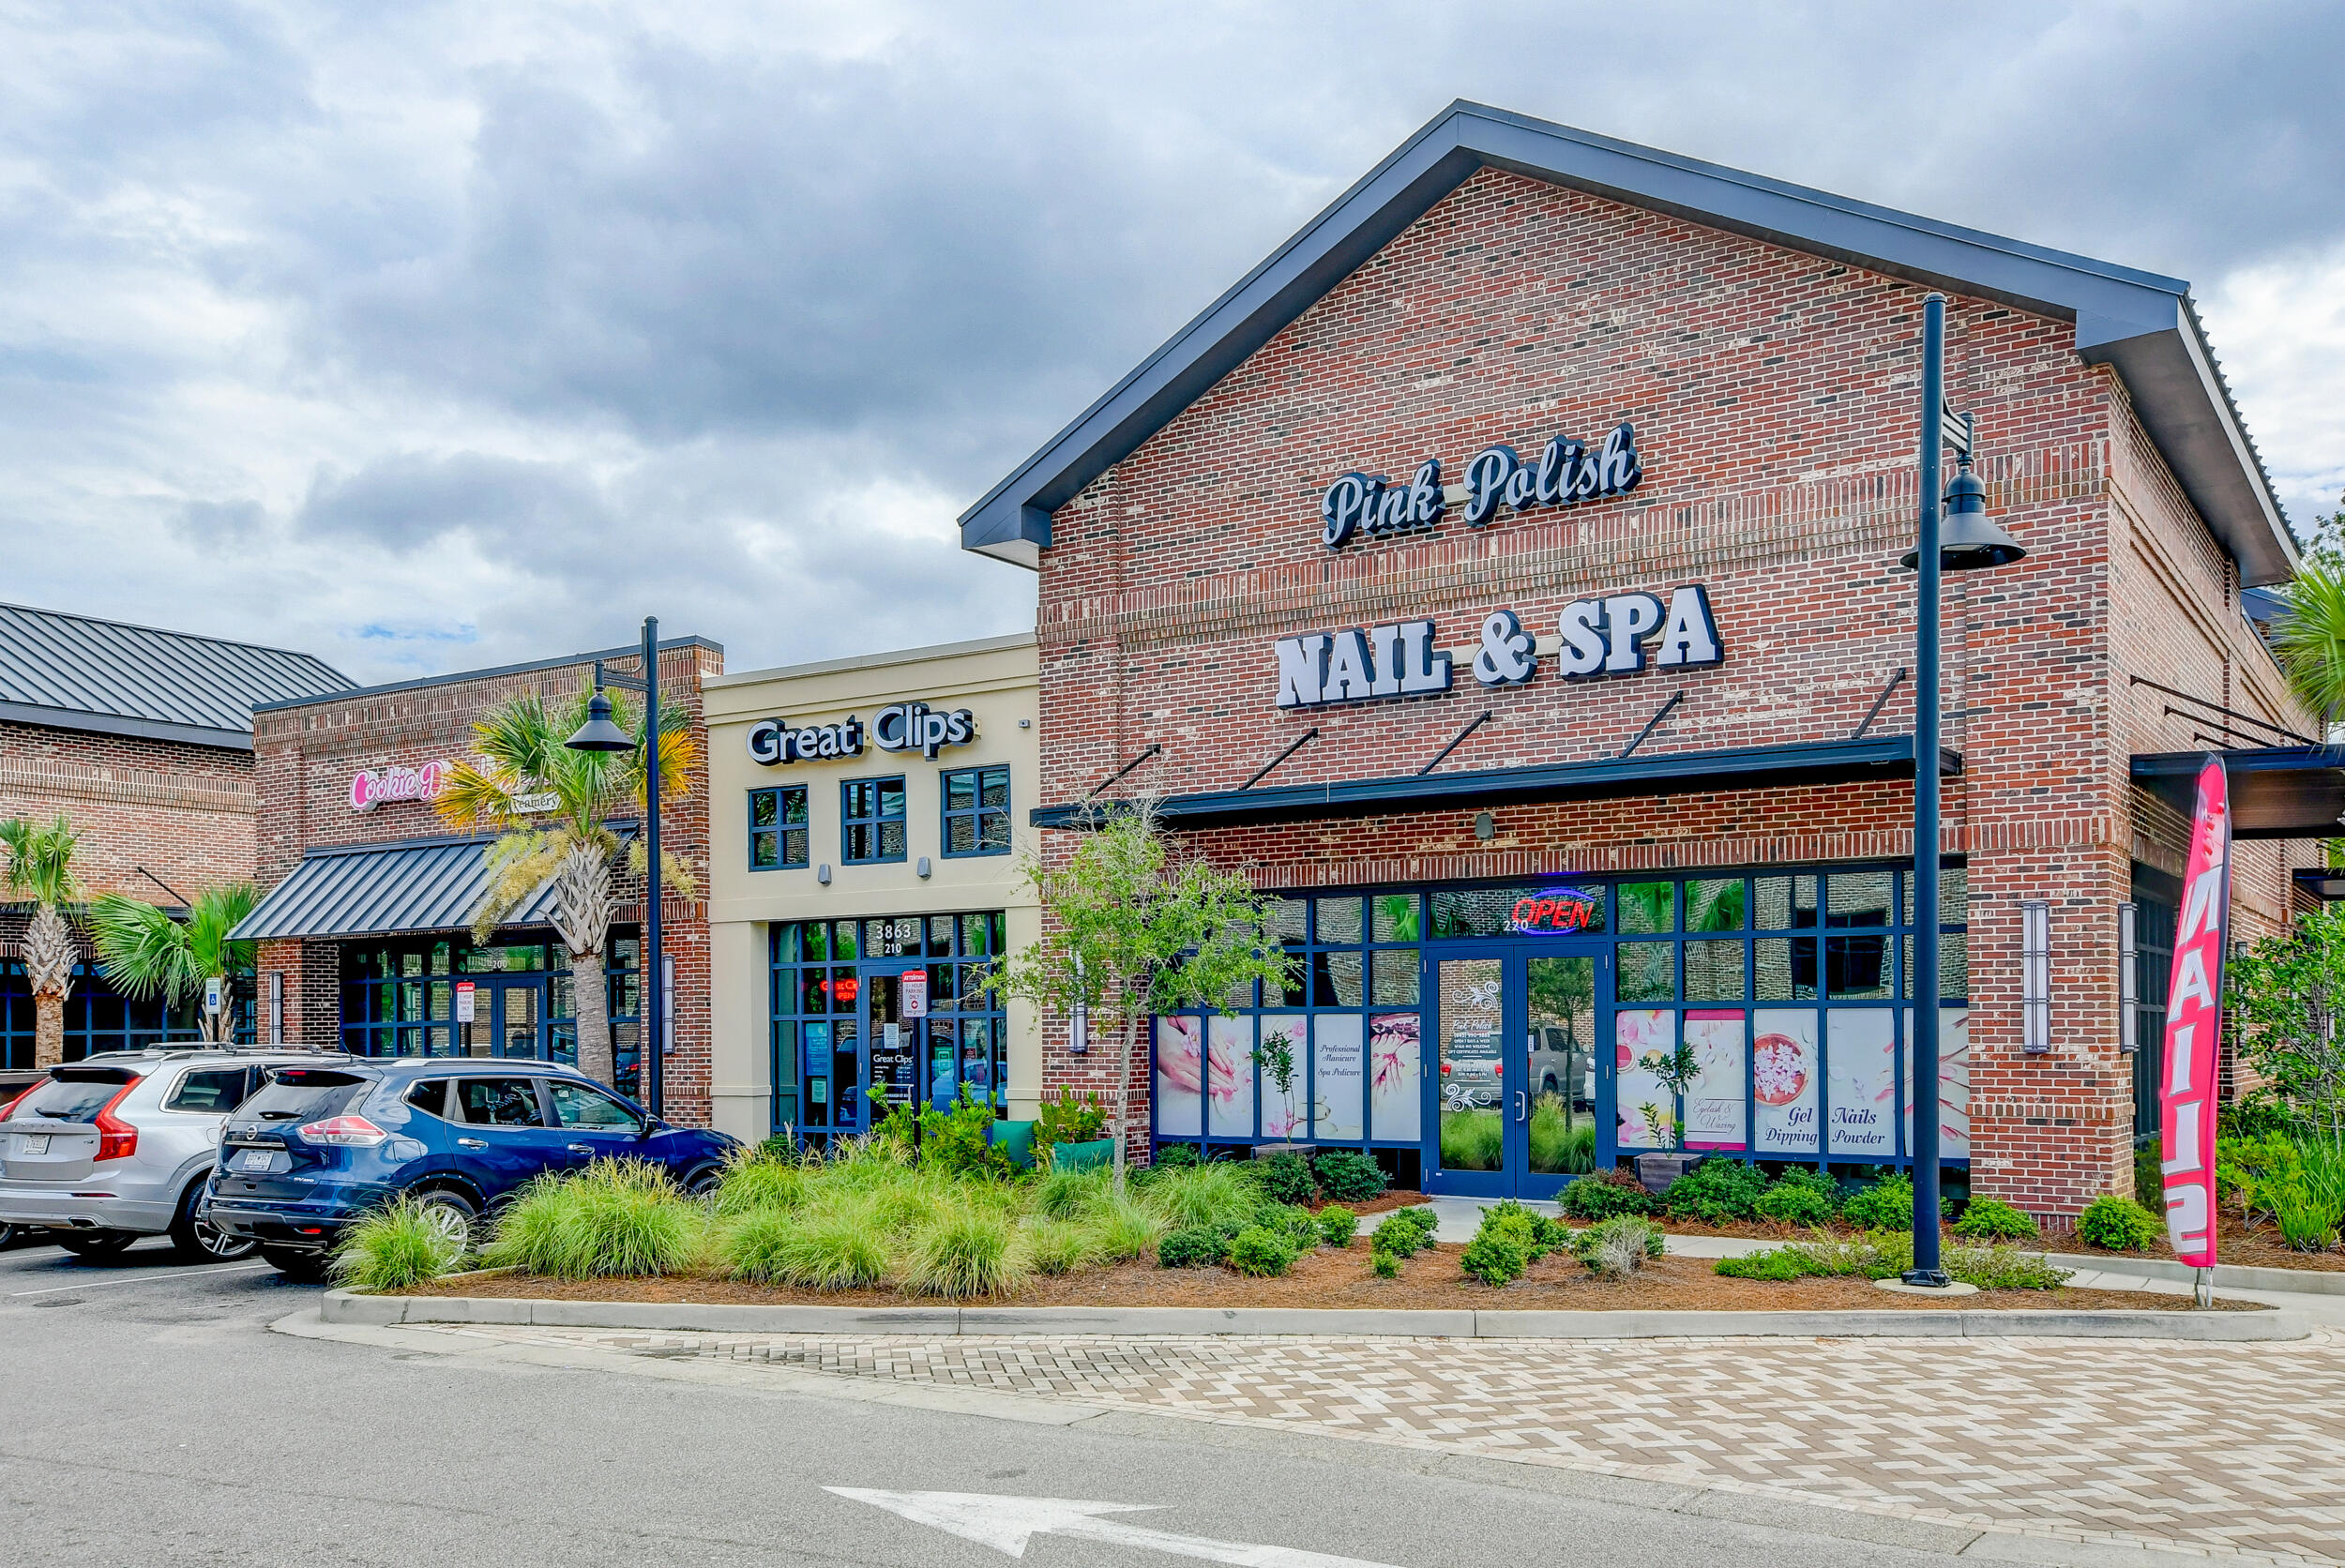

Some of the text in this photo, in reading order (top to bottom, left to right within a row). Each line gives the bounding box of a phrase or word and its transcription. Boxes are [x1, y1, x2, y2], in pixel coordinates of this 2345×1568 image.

[1321, 424, 1640, 550] Pink Polish
[1276, 585, 1723, 708] NAIL & SPA
[747, 703, 971, 764] Great Clips
[351, 766, 416, 809] Cookie
[1512, 898, 1594, 927] OPEN
[876, 925, 911, 939] 3863
[1504, 920, 1528, 931] 220
[885, 943, 901, 954] 210
[492, 960, 507, 969] 200
[1452, 1019, 1492, 1031] Pink Polish
[1320, 1045, 1360, 1053] Professional
[873, 1054, 894, 1063] Great
[1318, 1068, 1330, 1078] Spa
[1693, 1097, 1724, 1119] Eyelash
[1788, 1107, 1876, 1126] Gel Nails
[1701, 1114, 1736, 1134] Waxing
[1764, 1128, 1885, 1145] Dipping Powder
